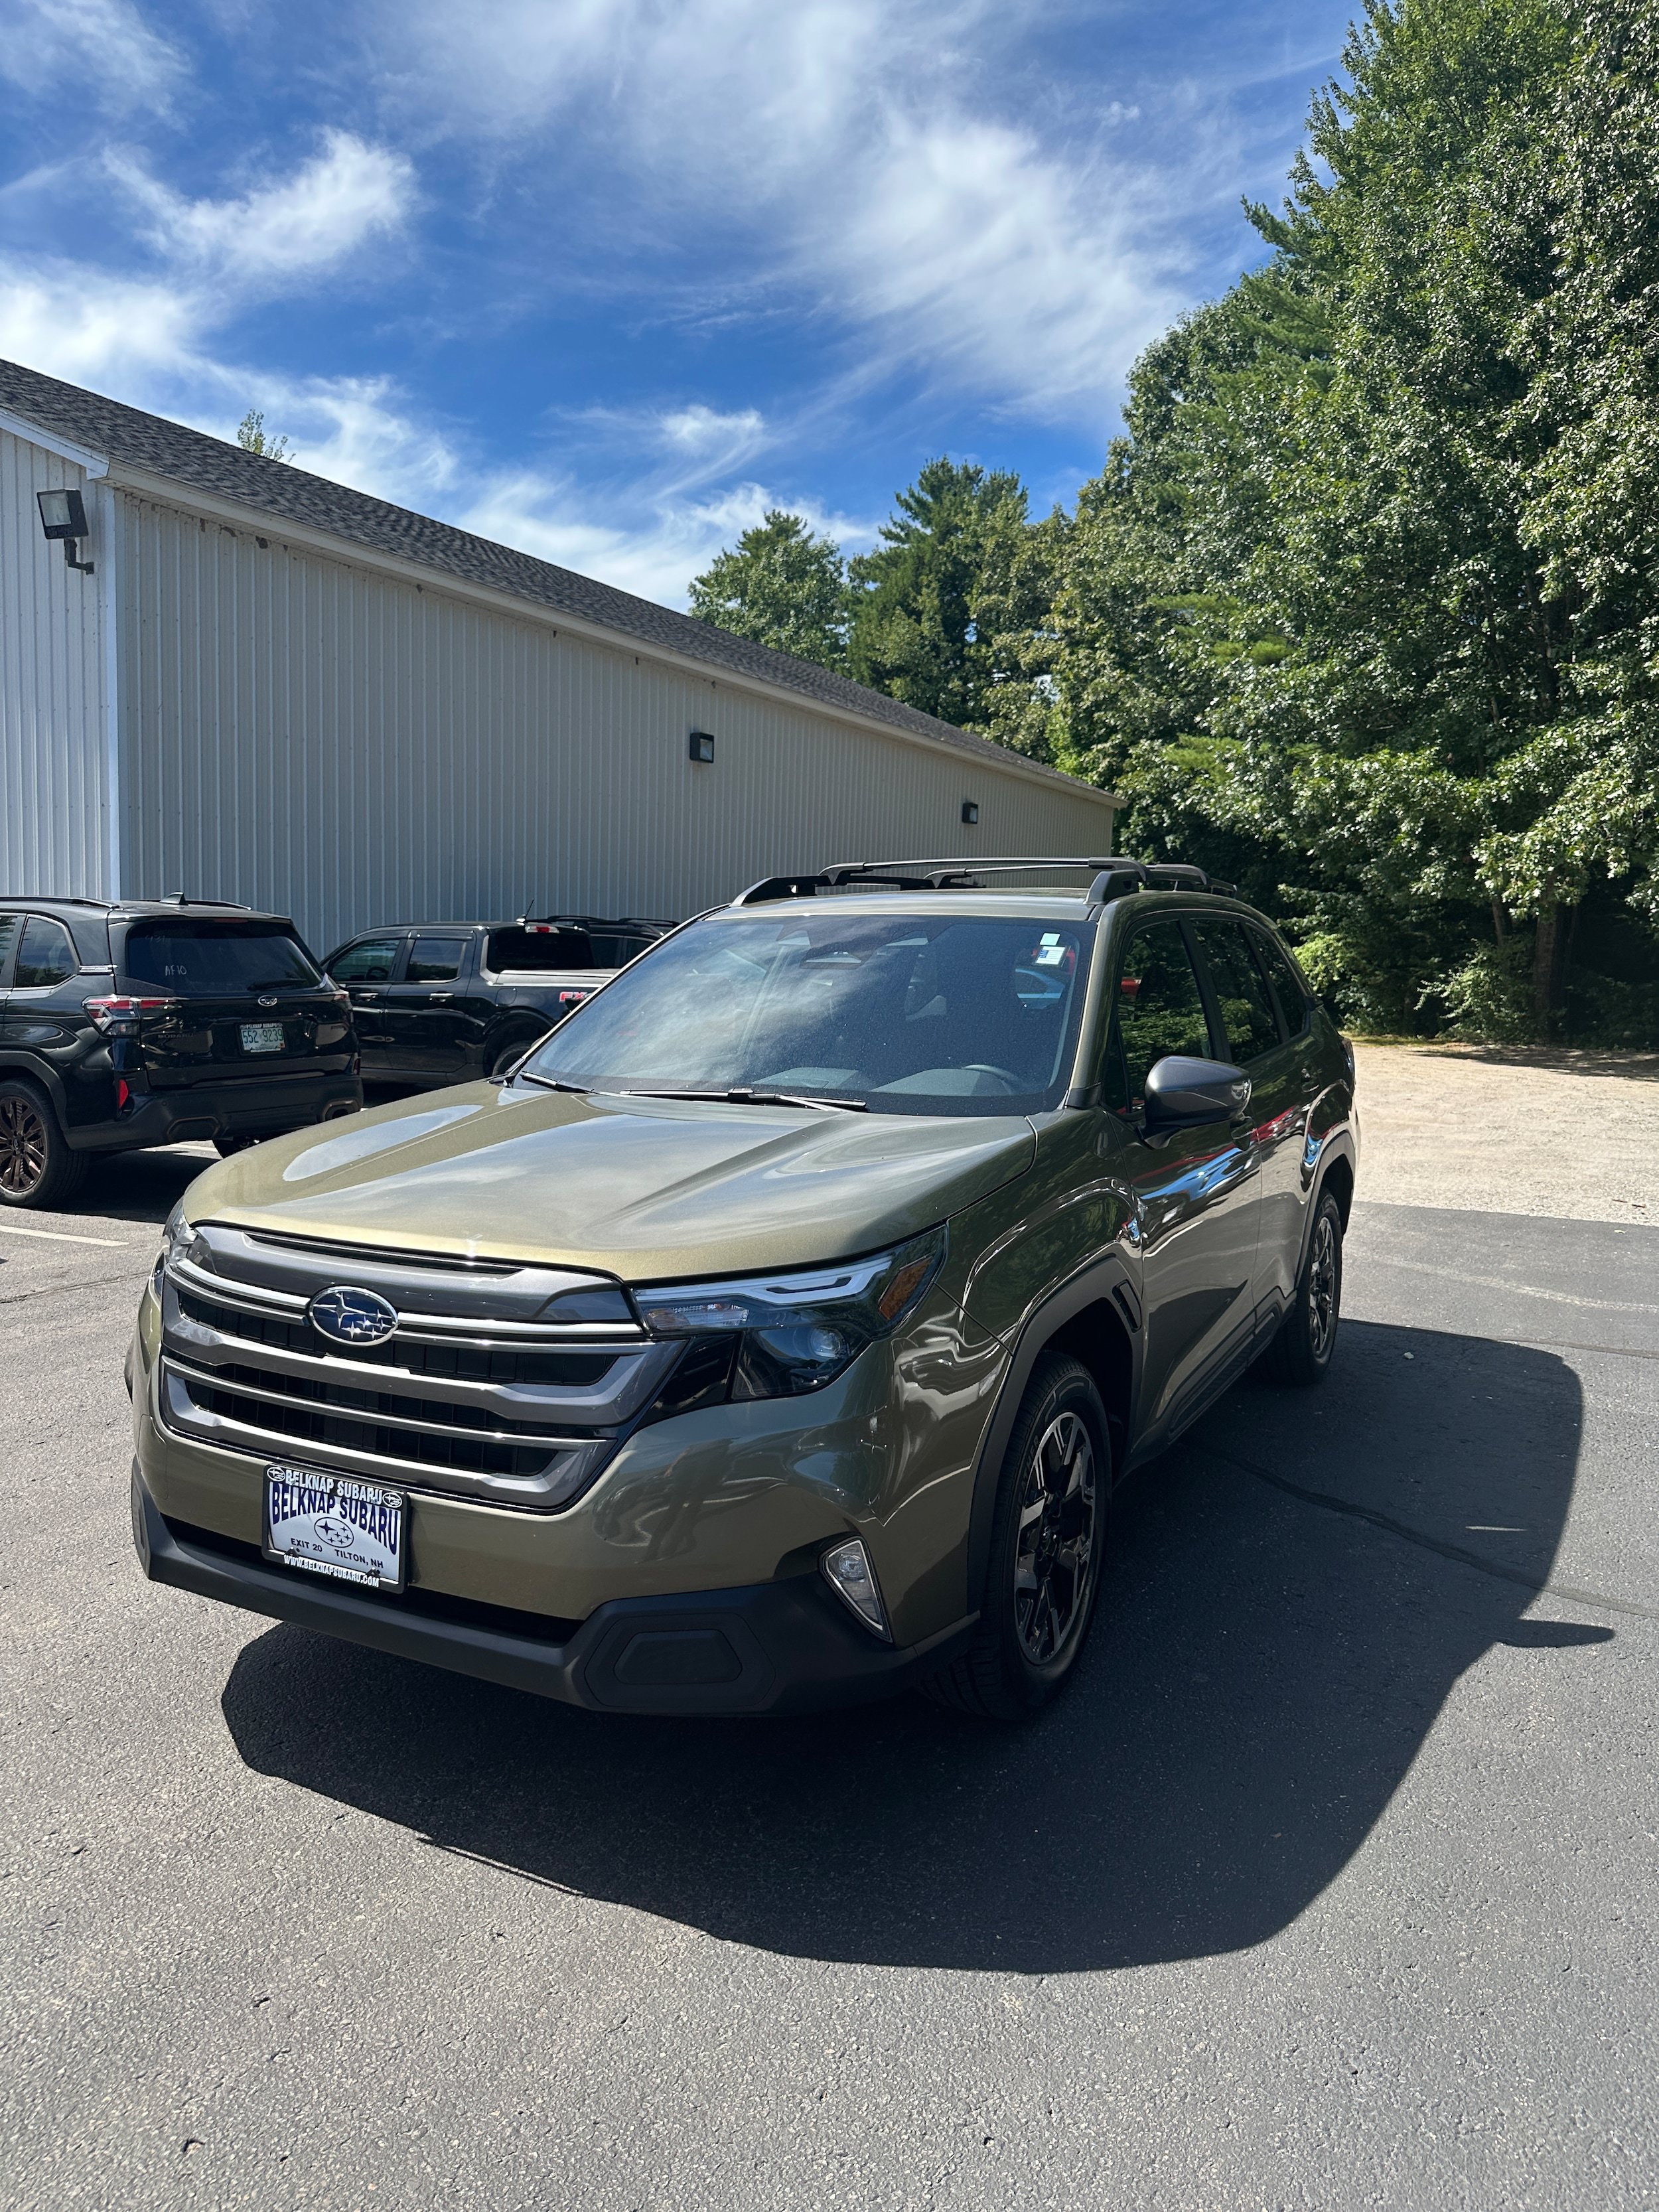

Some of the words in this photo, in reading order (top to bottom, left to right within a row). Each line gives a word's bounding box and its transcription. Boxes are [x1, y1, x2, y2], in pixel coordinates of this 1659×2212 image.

[242, 1030, 259, 1044] 552
[262, 1029, 283, 1042] 9239
[285, 1469, 334, 1493] BELKNAP
[336, 1481, 384, 1505] SUBARU
[272, 1483, 336, 1526] BELKNAP
[339, 1498, 398, 1556] SUBARU
[291, 1538, 310, 1550] EXIT
[313, 1544, 323, 1553] 20
[334, 1549, 368, 1566] TILTON,
[370, 1558, 384, 1569] NH
[283, 1554, 380, 1588] WWW.BELKNAPSUBARU.COM
